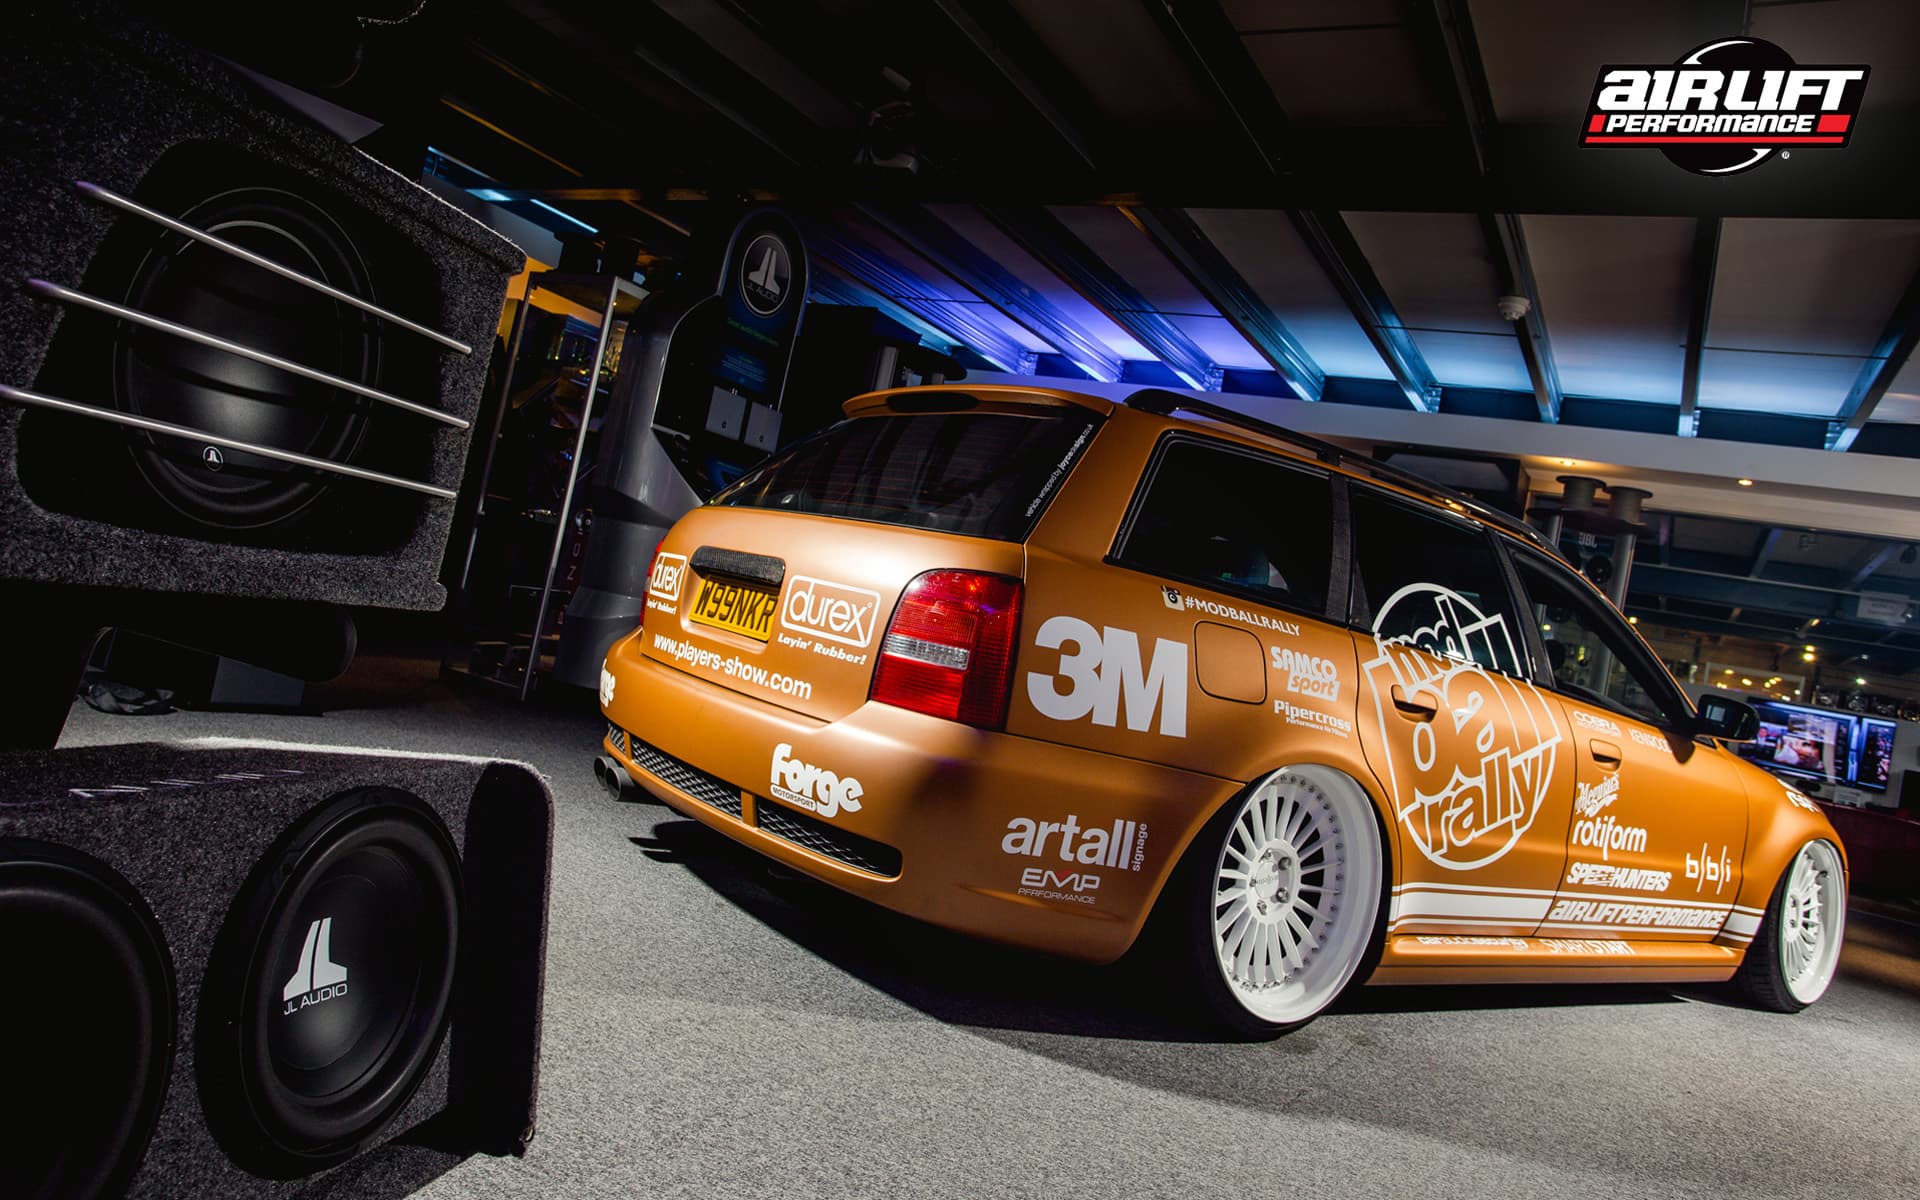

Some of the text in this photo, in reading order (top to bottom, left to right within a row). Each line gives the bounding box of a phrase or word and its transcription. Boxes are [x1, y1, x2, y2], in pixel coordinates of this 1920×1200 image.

[694, 579, 779, 633] W99NKR
[788, 581, 870, 644] durex
[1184, 595, 1300, 637] #MODBALLRALLY
[654, 633, 813, 700] www.players-show.com
[777, 632, 868, 665] Layin' Rubber!
[1271, 646, 1337, 681] SAMCO
[1027, 615, 1189, 739] 3M
[1274, 699, 1351, 732] Pipercross
[772, 786, 815, 809] MOTORSPORT
[1002, 815, 1149, 872] artall signage
[1572, 816, 1648, 861] rotiform
[1021, 868, 1101, 892] EMP
[283, 983, 348, 1015] JL AUDIO
